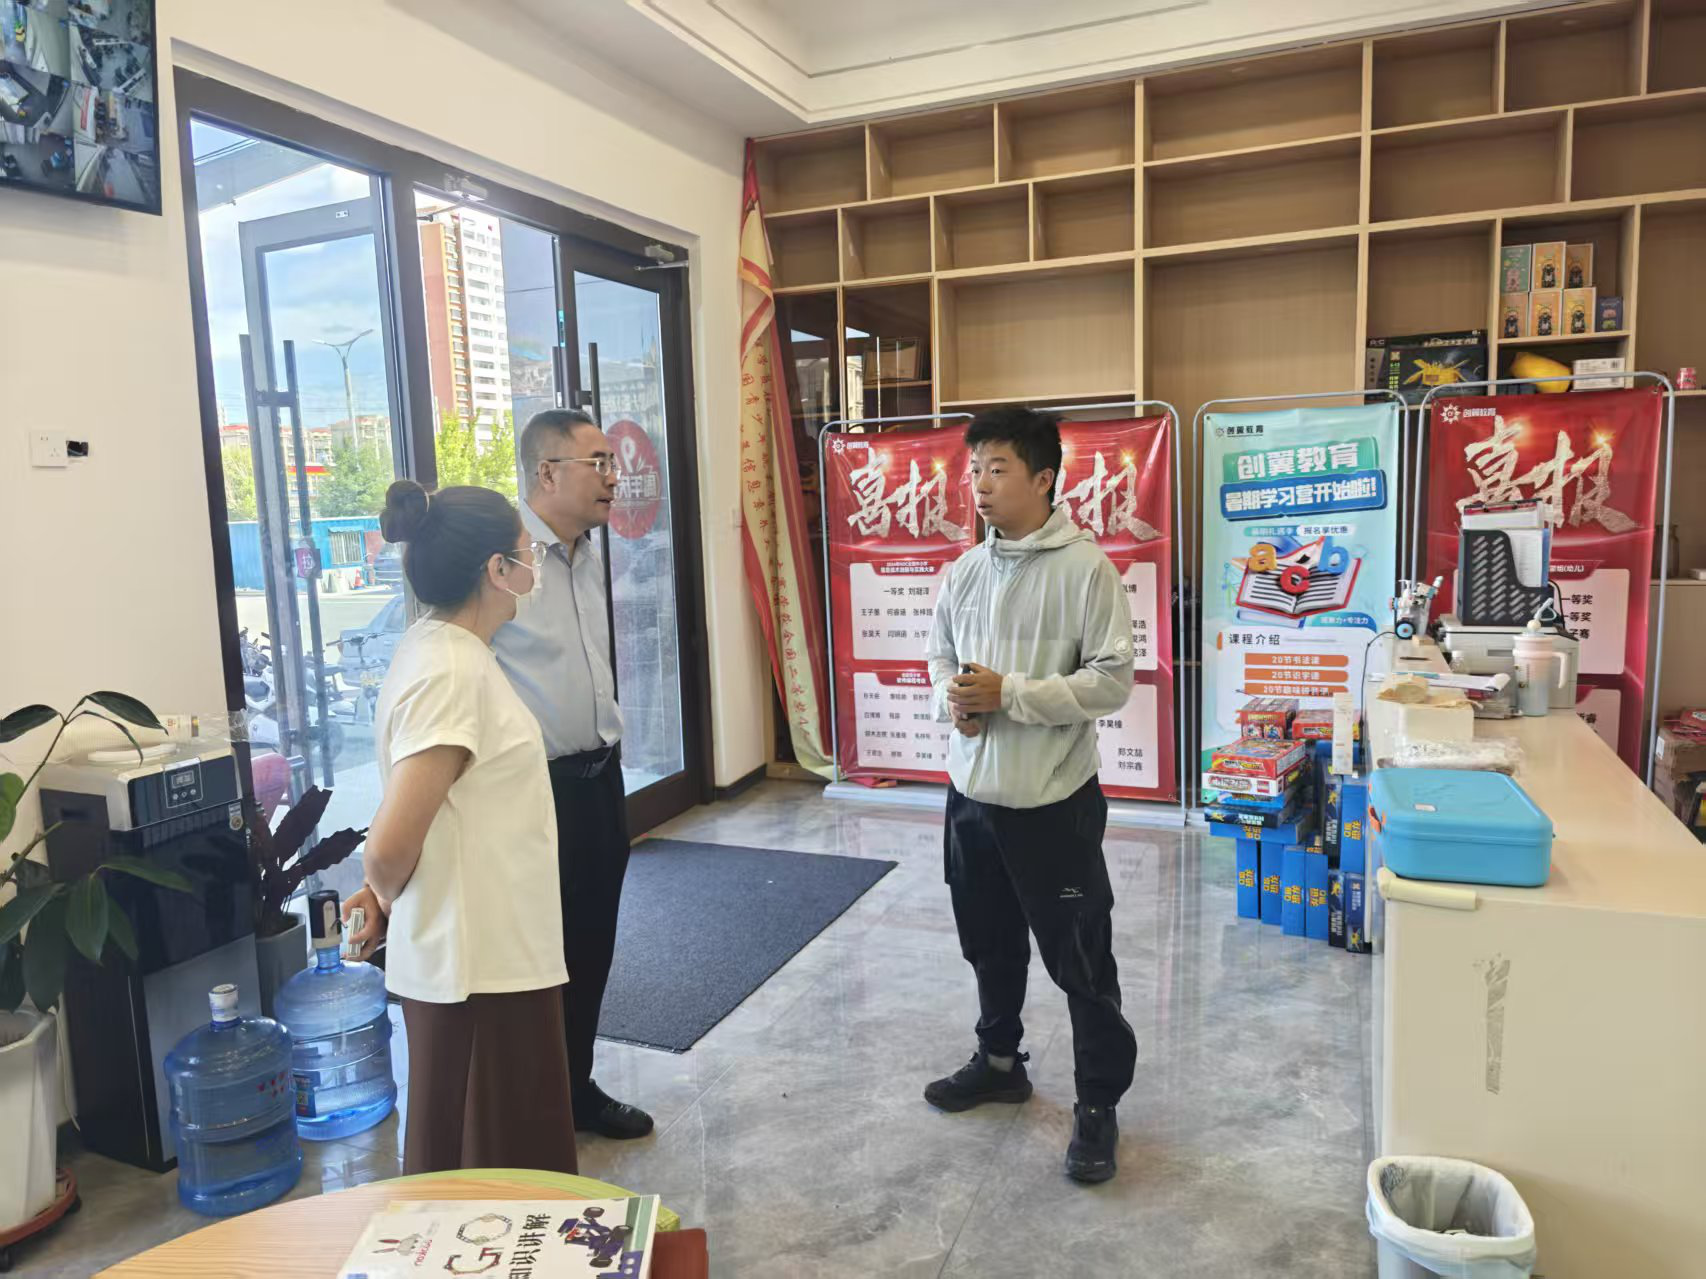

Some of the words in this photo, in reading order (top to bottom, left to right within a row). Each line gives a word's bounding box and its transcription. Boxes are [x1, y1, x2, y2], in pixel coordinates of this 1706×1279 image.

[1237, 442, 1360, 481] 创翼教育
[1456, 414, 1641, 534] 喜报
[847, 447, 972, 542] 喜报
[1053, 450, 1163, 541] 报
[1225, 477, 1377, 512] 暑期学习营开始啦!
[1229, 633, 1281, 646] 课程介绍
